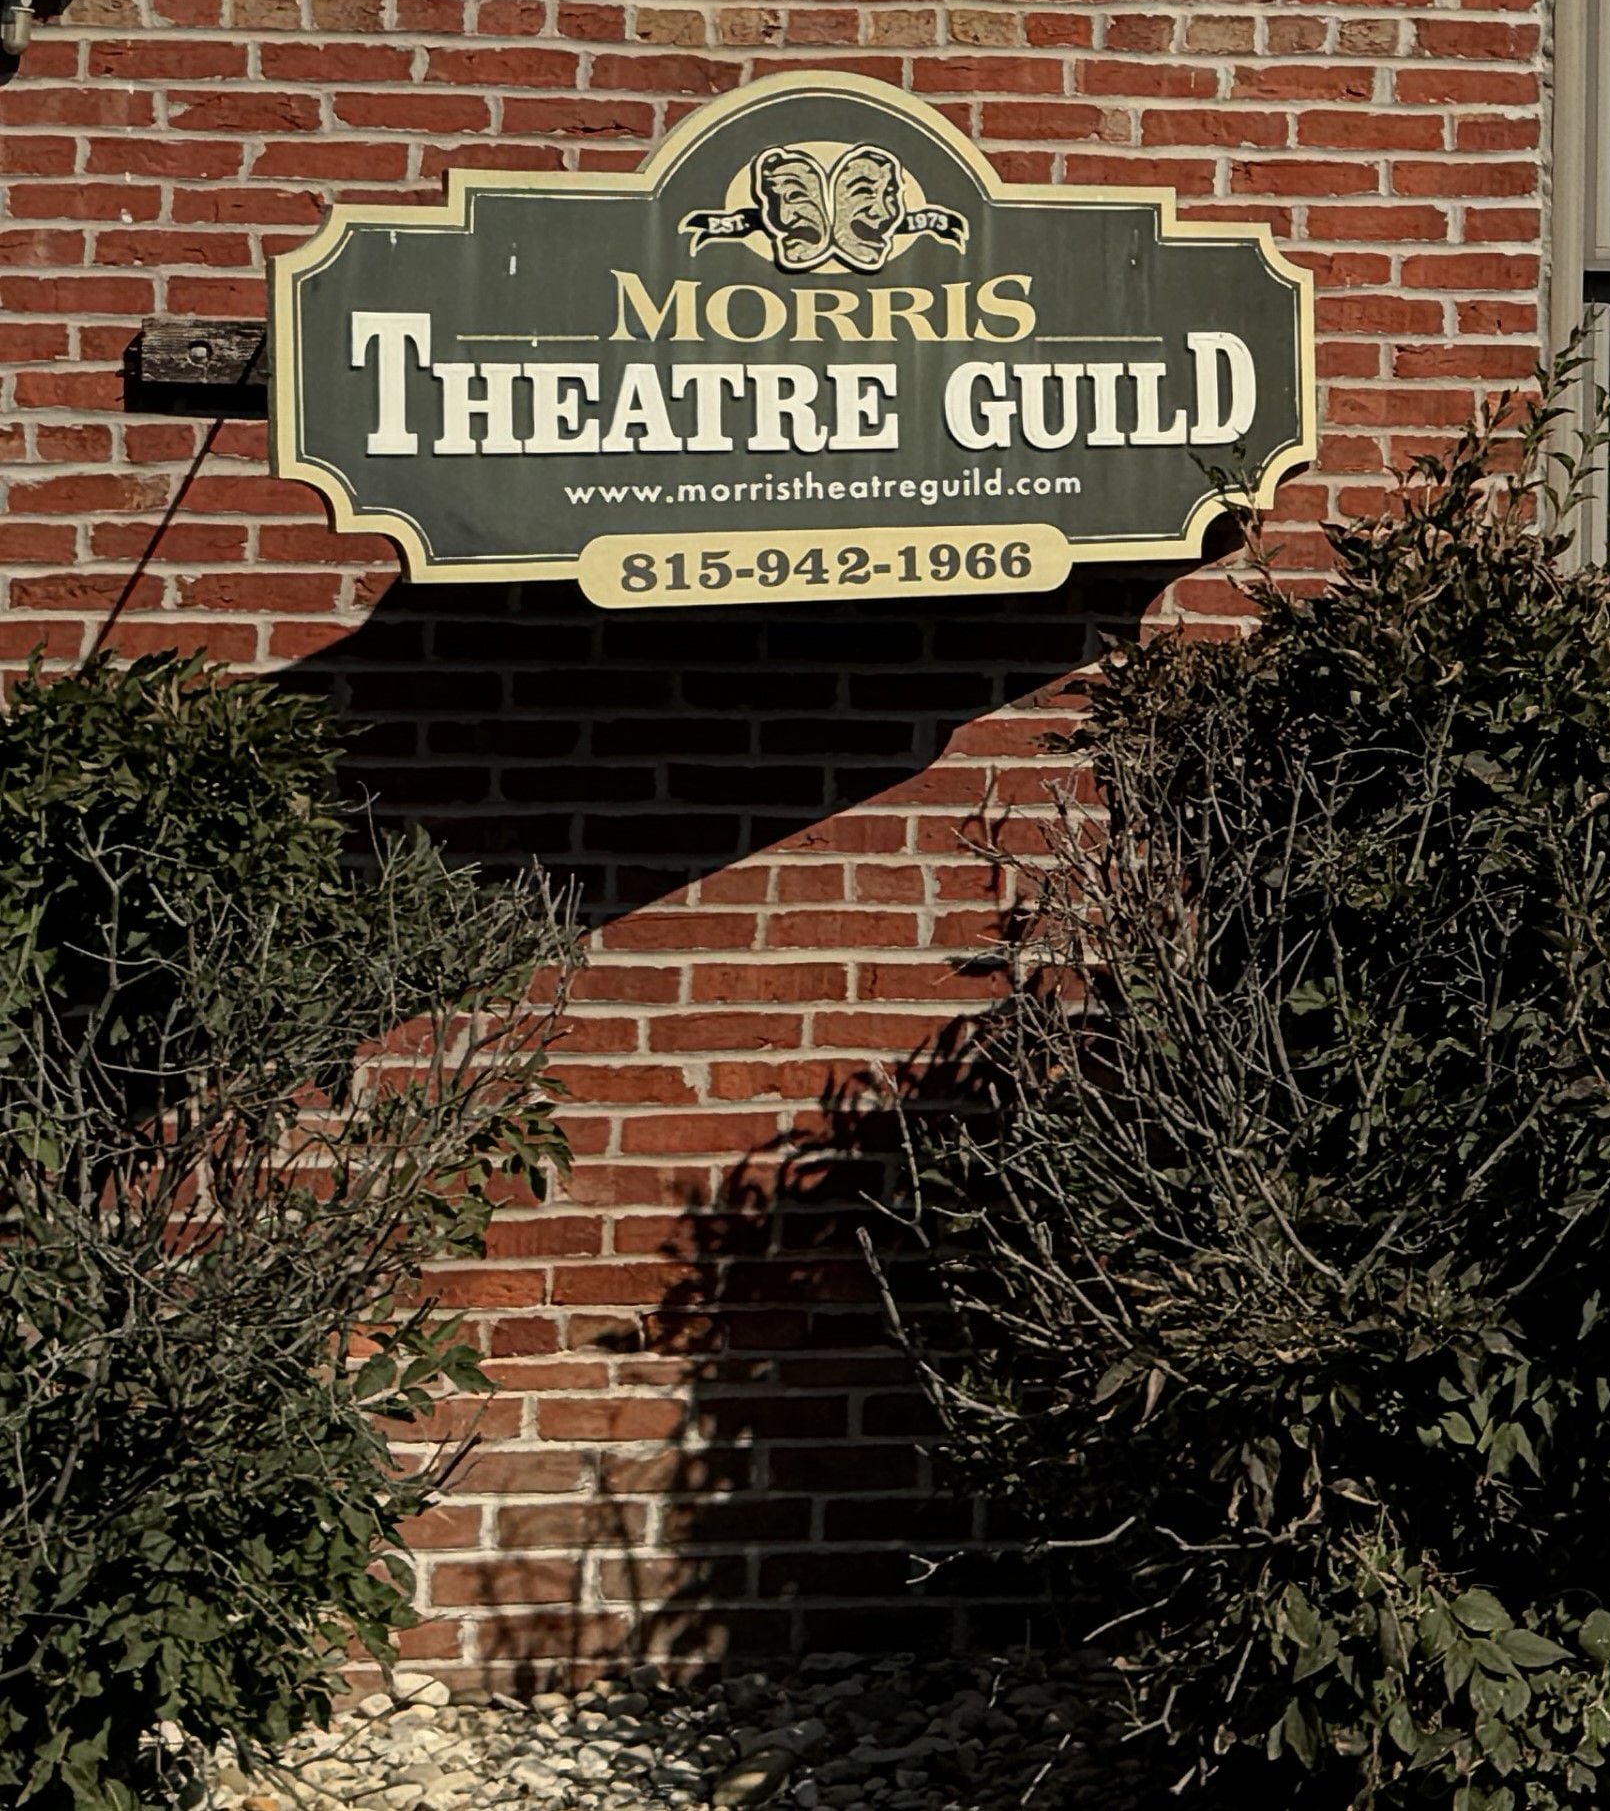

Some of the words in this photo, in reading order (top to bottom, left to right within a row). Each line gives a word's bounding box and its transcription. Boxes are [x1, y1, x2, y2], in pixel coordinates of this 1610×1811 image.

[708, 214, 750, 233] EST.
[906, 212, 949, 232] 1973
[610, 270, 1036, 343] MORRIS
[350, 311, 900, 456] THEATRE
[943, 330, 1258, 450] GUILD
[563, 467, 1081, 508] www.morristheatreguild.com
[619, 540, 1033, 593] 815-942-1966
